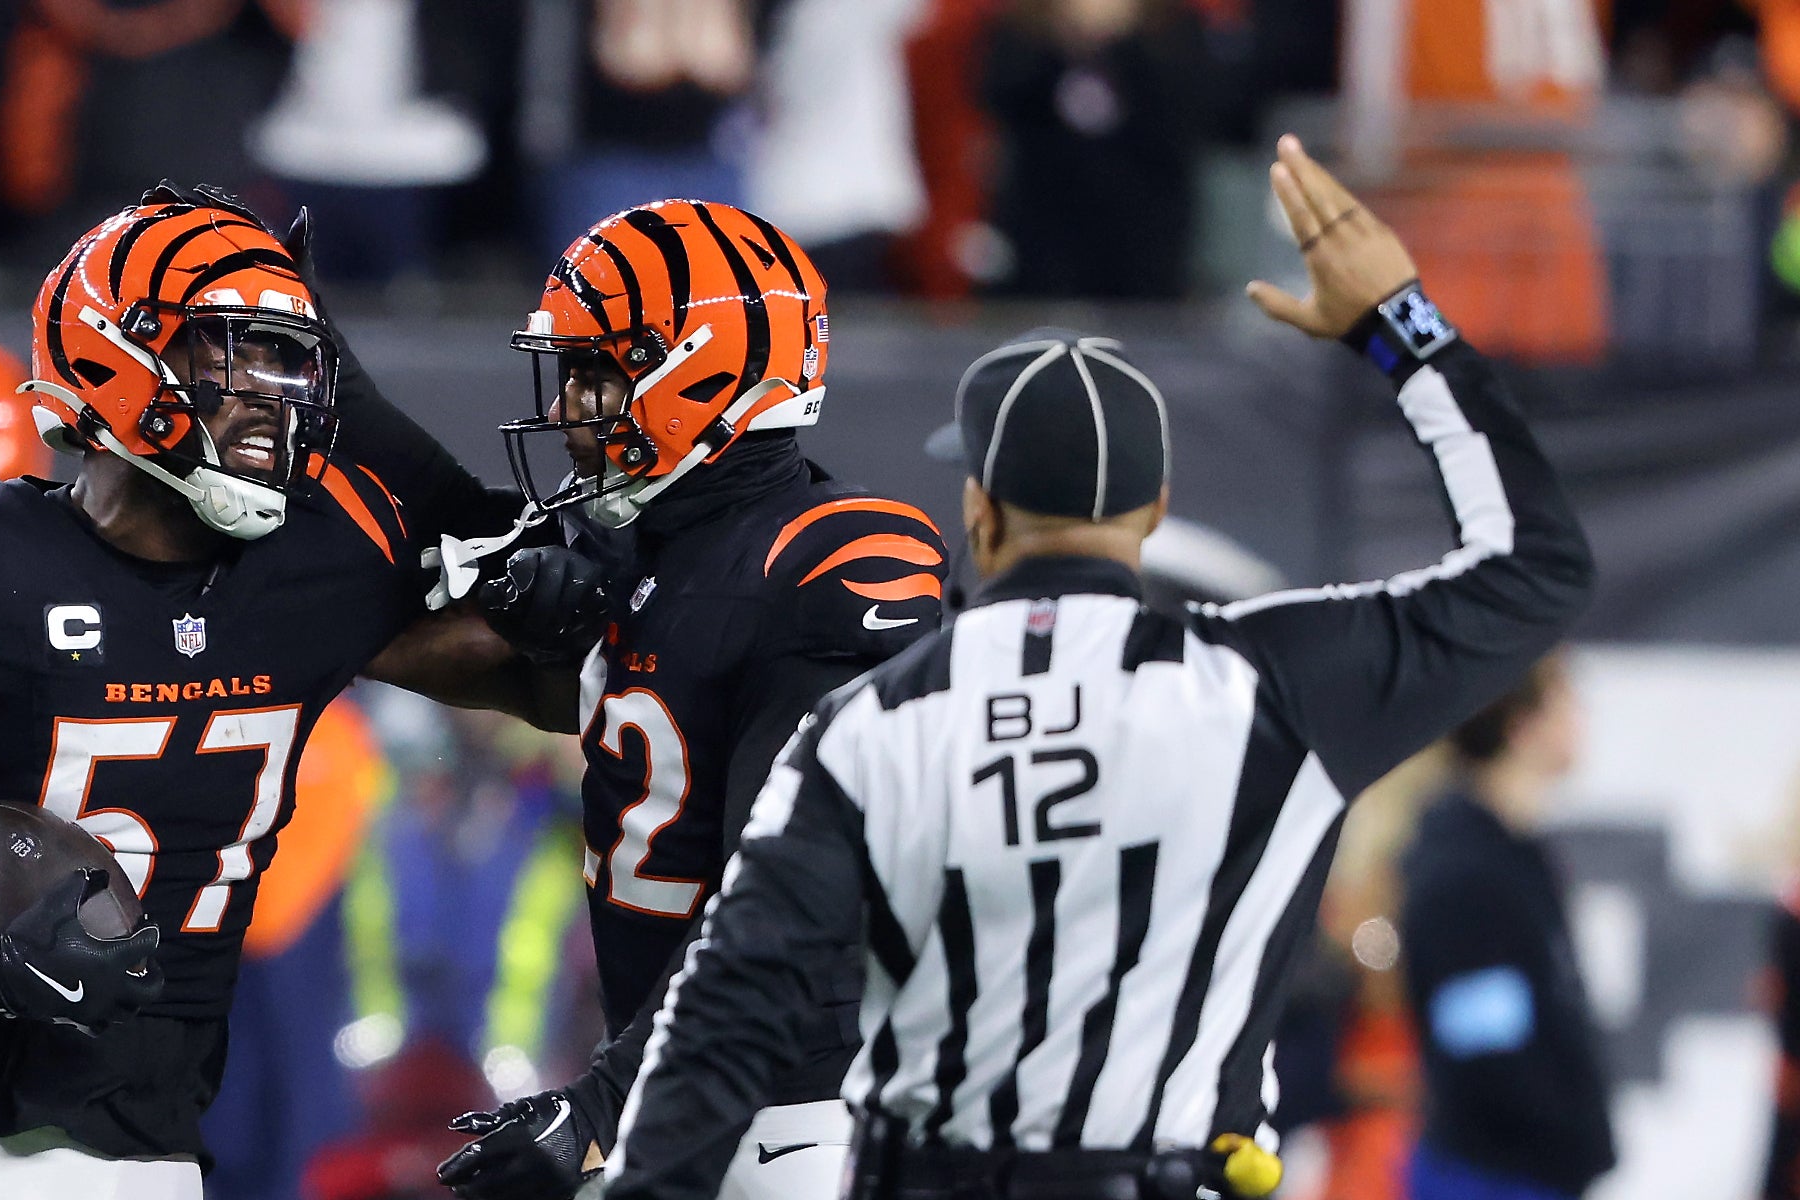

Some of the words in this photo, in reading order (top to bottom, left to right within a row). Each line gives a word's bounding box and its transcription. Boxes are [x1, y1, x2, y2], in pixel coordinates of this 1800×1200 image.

[47, 605, 102, 650] C
[104, 674, 273, 703] BENGALS
[988, 682, 1081, 742] BJ
[37, 702, 303, 933] 57
[973, 748, 1102, 846] 12
[11, 839, 31, 858] 183
